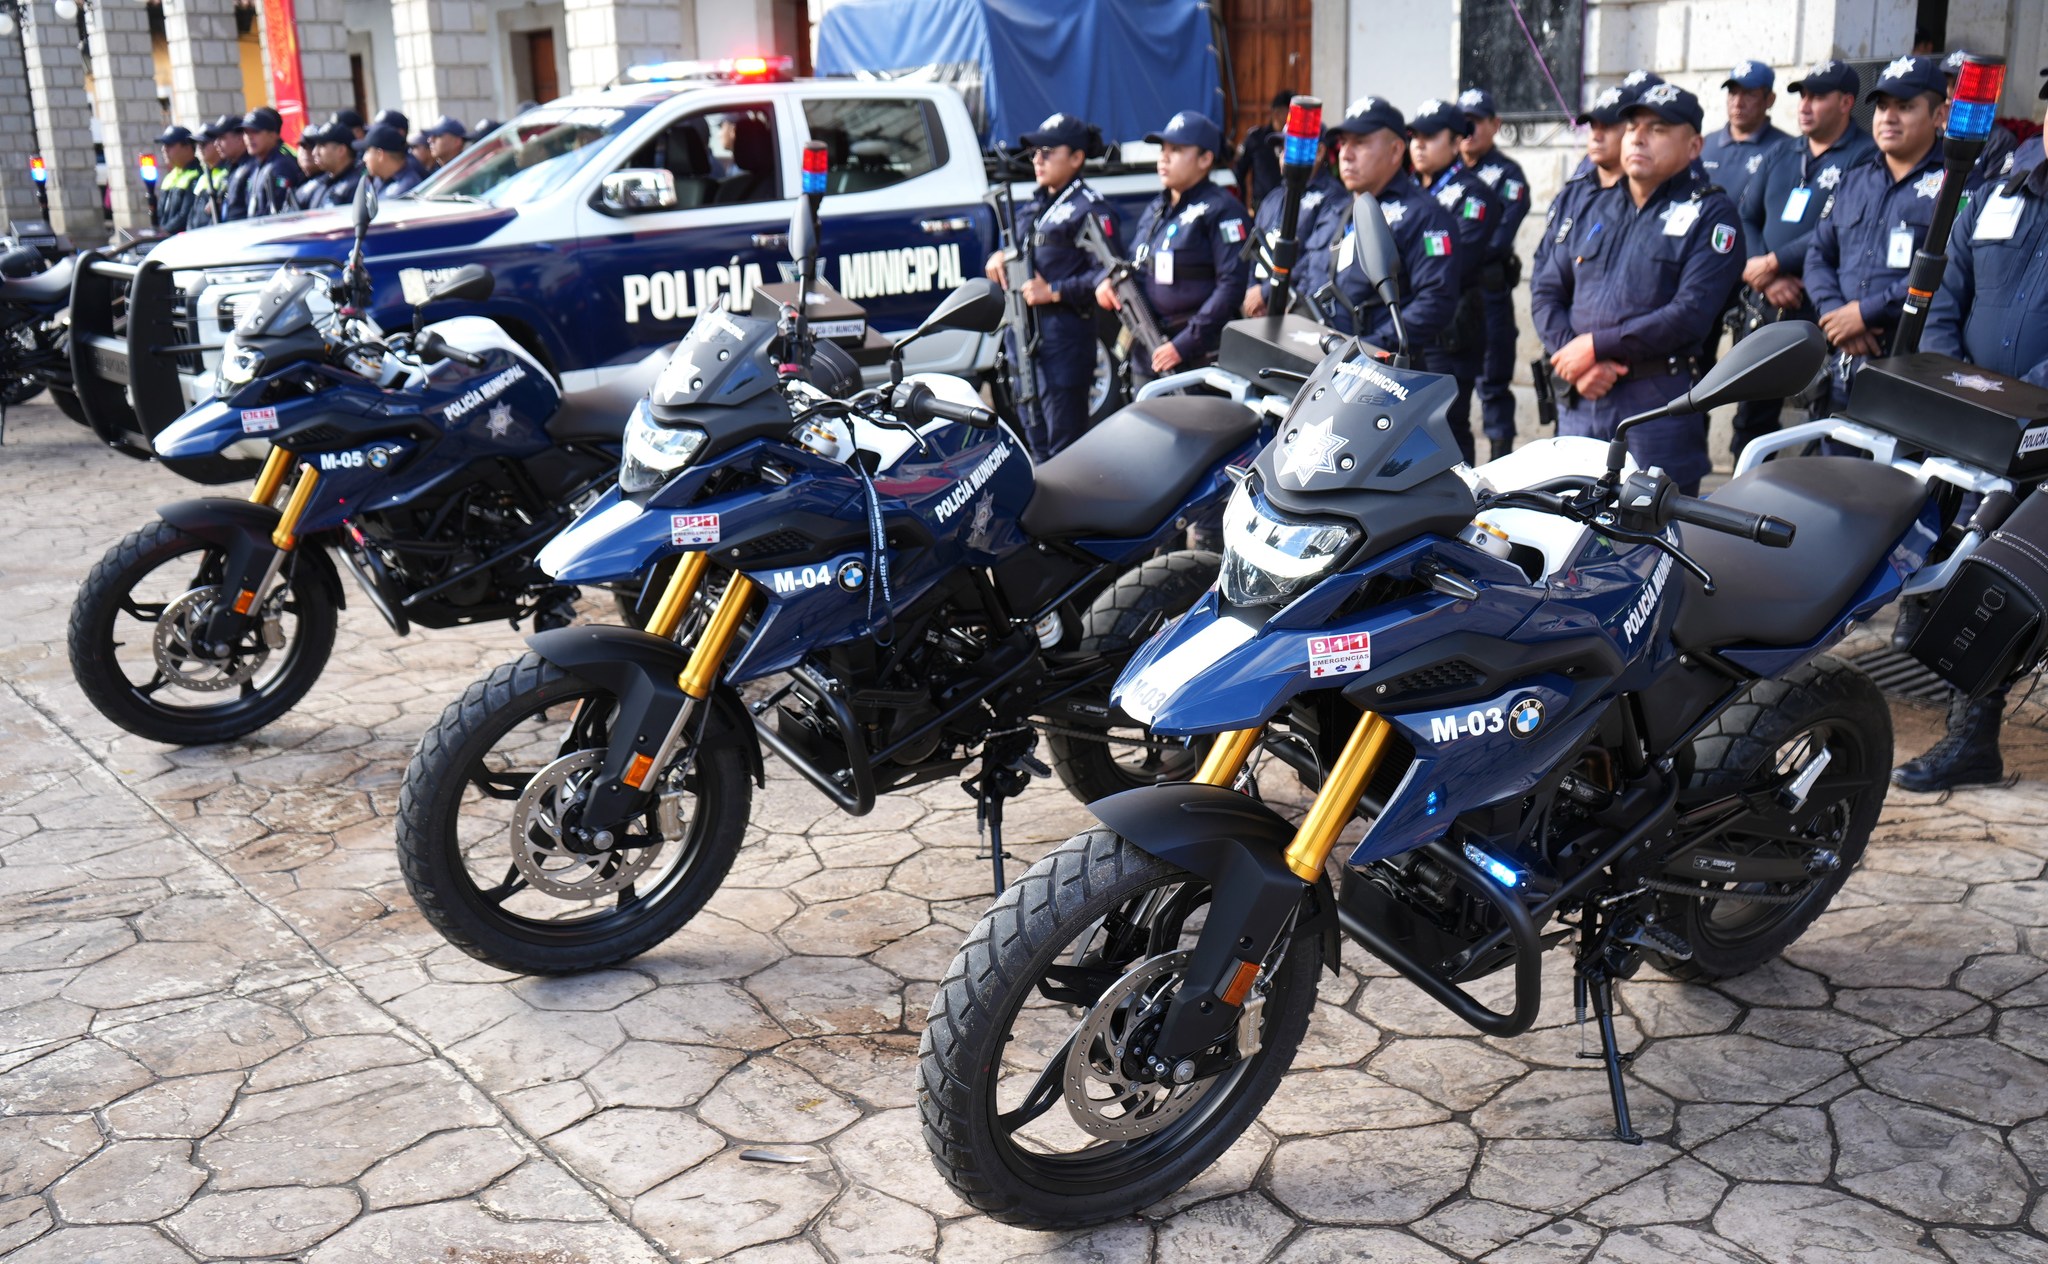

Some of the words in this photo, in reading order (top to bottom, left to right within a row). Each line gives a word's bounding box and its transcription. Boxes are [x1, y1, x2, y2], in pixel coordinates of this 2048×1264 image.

[623, 255, 765, 323] POLICÍA
[839, 243, 967, 299] MUNICIPAL
[479, 363, 527, 400] MUNICIPAL
[1361, 366, 1410, 401] MUNICIPAL
[319, 451, 364, 470] M-05
[934, 479, 975, 523] POLICÍA
[969, 441, 1010, 491] MUNICIPAL
[774, 565, 832, 593] M-04
[1623, 584, 1658, 644] POLICÍA
[1312, 635, 1366, 653] 911
[1312, 654, 1370, 666] EMERGENCIAS
[1430, 707, 1505, 743] M-03
